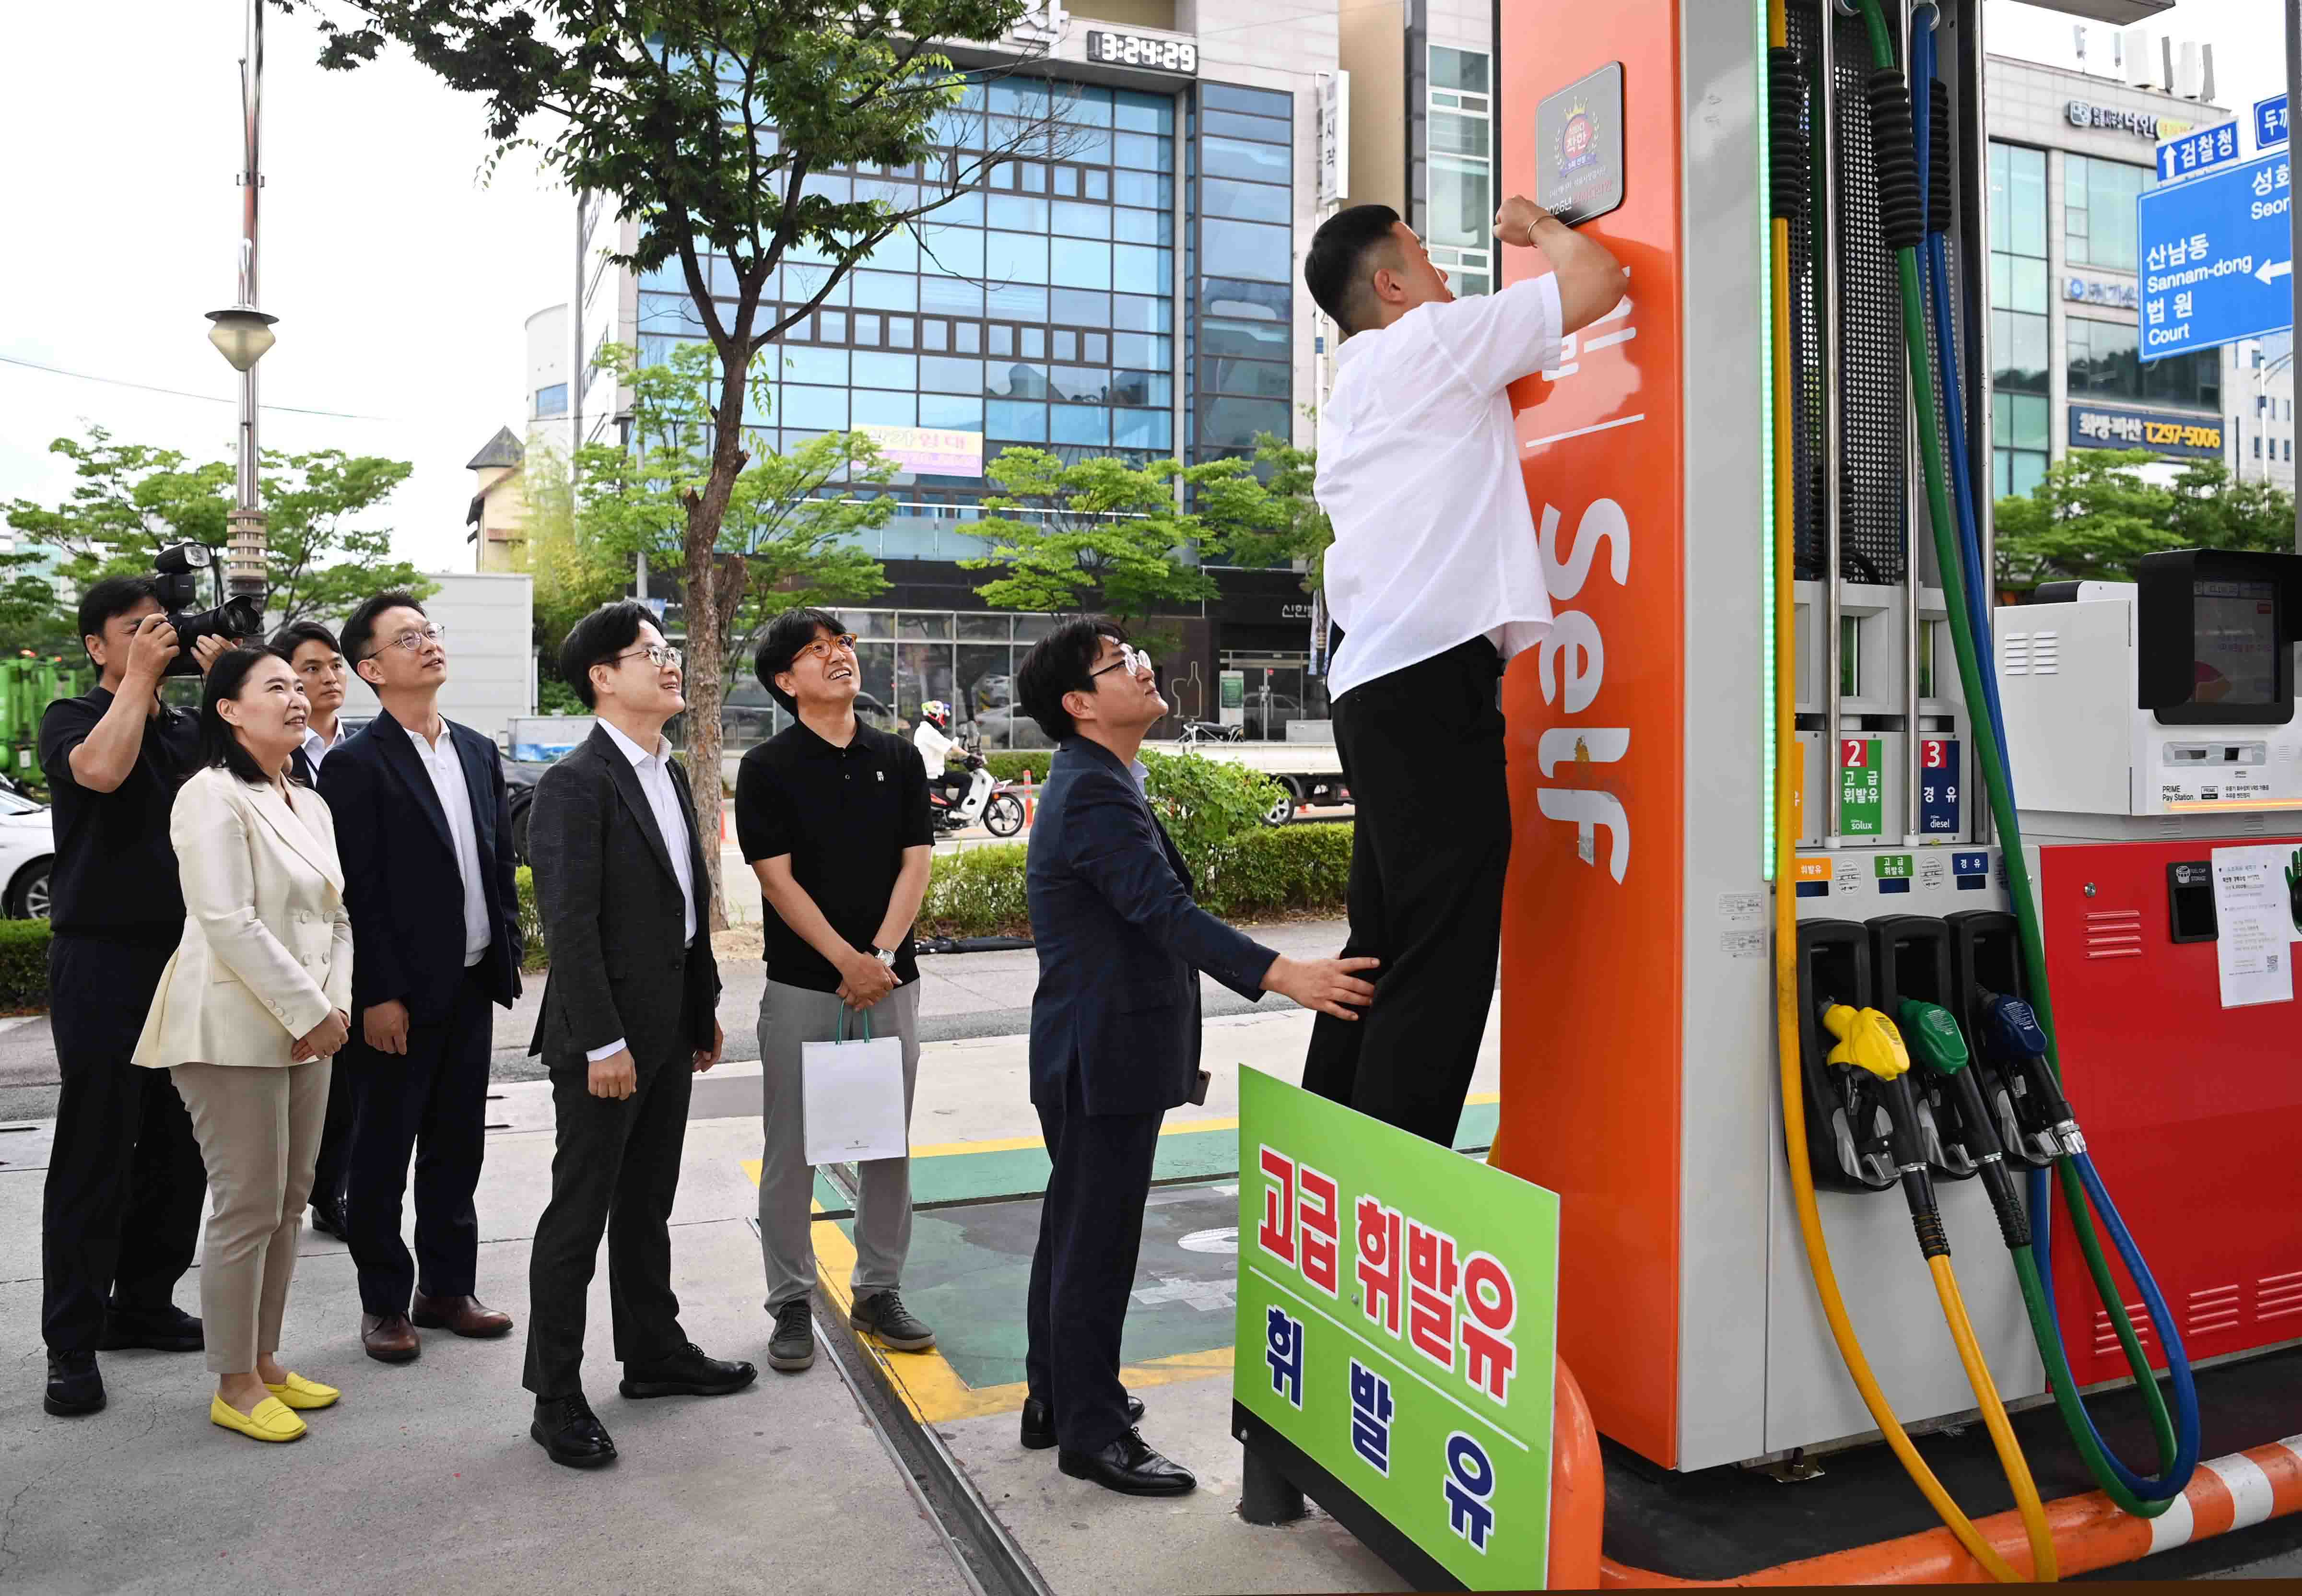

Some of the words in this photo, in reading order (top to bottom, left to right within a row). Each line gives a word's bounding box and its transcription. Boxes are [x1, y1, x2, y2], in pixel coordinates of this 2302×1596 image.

[2180, 128, 2233, 169] 검찰청
[2147, 233, 2209, 271] 산남동
[2147, 255, 2252, 293] Sannam-dong
[2149, 323, 2190, 345] Court
[1537, 497, 1631, 886] Self
[1847, 740, 1861, 767] 2
[1927, 741, 1940, 767] 3
[1844, 788, 1879, 803] 휘발유
[1851, 821, 1872, 830] solux
[1930, 818, 1950, 828] diesel
[1801, 865, 1822, 875] 휘발유
[1884, 866, 1904, 875] 휘발유
[1258, 1143, 1339, 1300] 고급
[1355, 1192, 1516, 1407] 휘발유
